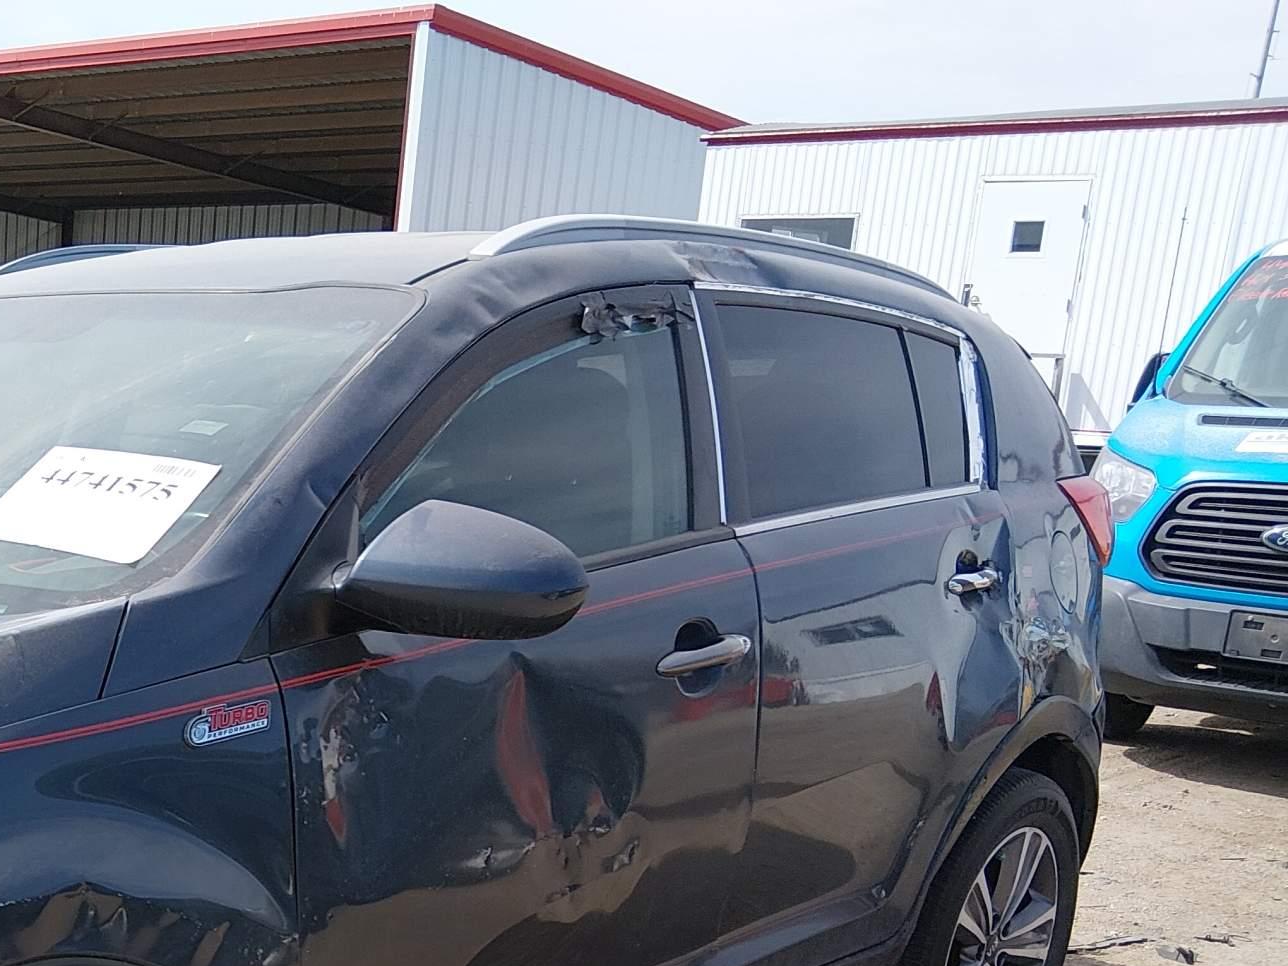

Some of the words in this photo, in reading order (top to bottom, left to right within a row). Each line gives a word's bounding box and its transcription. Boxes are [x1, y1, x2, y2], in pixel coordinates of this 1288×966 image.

[41, 468, 179, 501] 44741575
[207, 720, 265, 739] PERFORMANCE
[208, 702, 268, 731] TURBO
